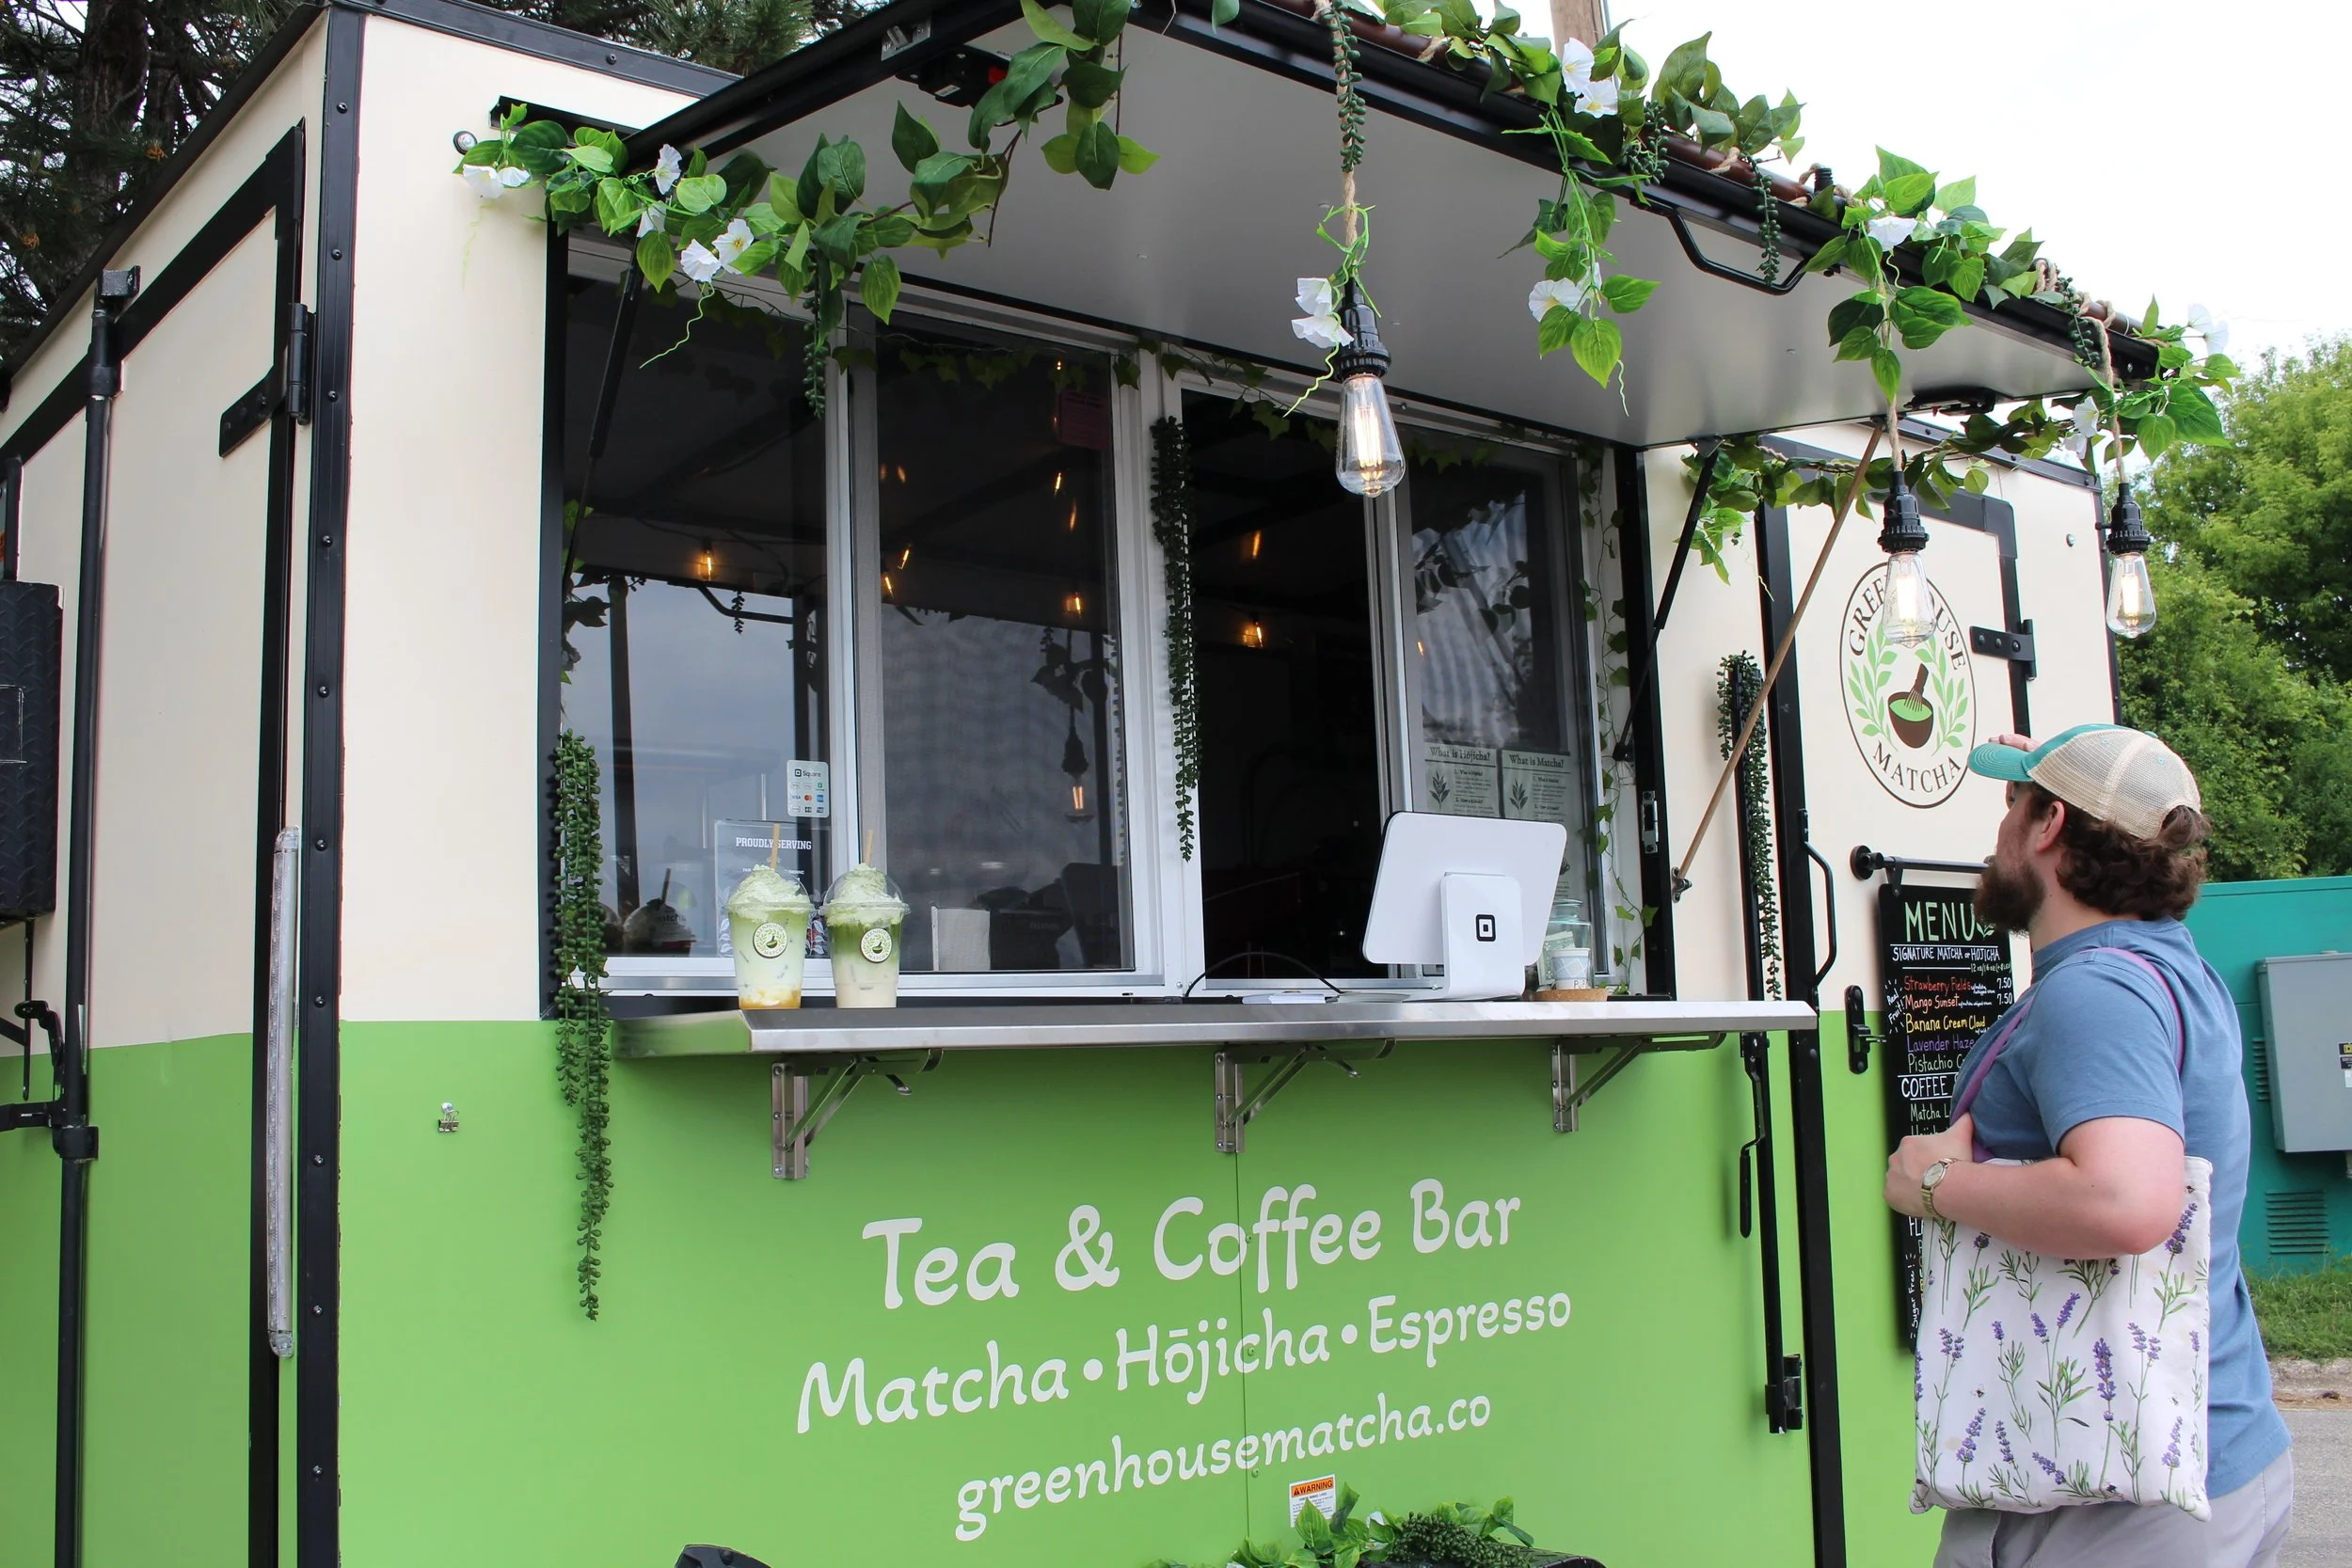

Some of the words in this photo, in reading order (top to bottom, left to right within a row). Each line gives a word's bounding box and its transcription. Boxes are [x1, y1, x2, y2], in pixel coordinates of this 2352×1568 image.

[1430, 746, 1450, 758] What
[1452, 749, 1458, 758] is
[1509, 754, 1529, 765] What
[1537, 756, 1564, 768] Matcha?
[803, 770, 821, 779] Square
[1873, 739, 1962, 794] MATCHA
[736, 837, 774, 848] PROUDLY
[1904, 901, 1975, 942] MENU
[1892, 946, 1934, 961] SIGNATURE
[1937, 947, 1963, 960] MATCHA
[1970, 948, 2000, 961] HOJICHA
[1970, 963, 1977, 973] 12
[1904, 975, 1949, 996] Strawberry
[1951, 976, 1972, 990] Fields
[1996, 977, 2011, 989] 7.50
[1886, 988, 1899, 1006] Real
[1905, 994, 1932, 1014] Mango
[1934, 993, 1960, 1009] Sunset
[1996, 992, 2013, 1005] 7.50
[1888, 999, 1906, 1025] Fruit!
[1905, 1013, 1941, 1034] Banana
[1943, 1015, 1967, 1030] Cream
[1968, 1015, 1986, 1030] Cloud
[1907, 1035, 1950, 1053] Lavender
[1952, 1035, 1975, 1050] Haze
[1907, 1053, 1953, 1073] Pistachio
[1901, 1075, 1948, 1098] COFFEE
[1910, 1103, 1941, 1122] Matcha
[863, 1214, 1020, 1309] Tea
[1056, 1205, 1120, 1291] &
[1154, 1184, 1382, 1293] Coffee
[1409, 1179, 1521, 1254] Bar
[1911, 1298, 1919, 1328] Sugar
[797, 1339, 1069, 1434] Matcha
[1116, 1307, 1330, 1405] Hōjicha
[1368, 1292, 1571, 1369] Espresso
[956, 1391, 1491, 1542] greenhousematcha.co
[1299, 1480, 1333, 1495] WARNING
